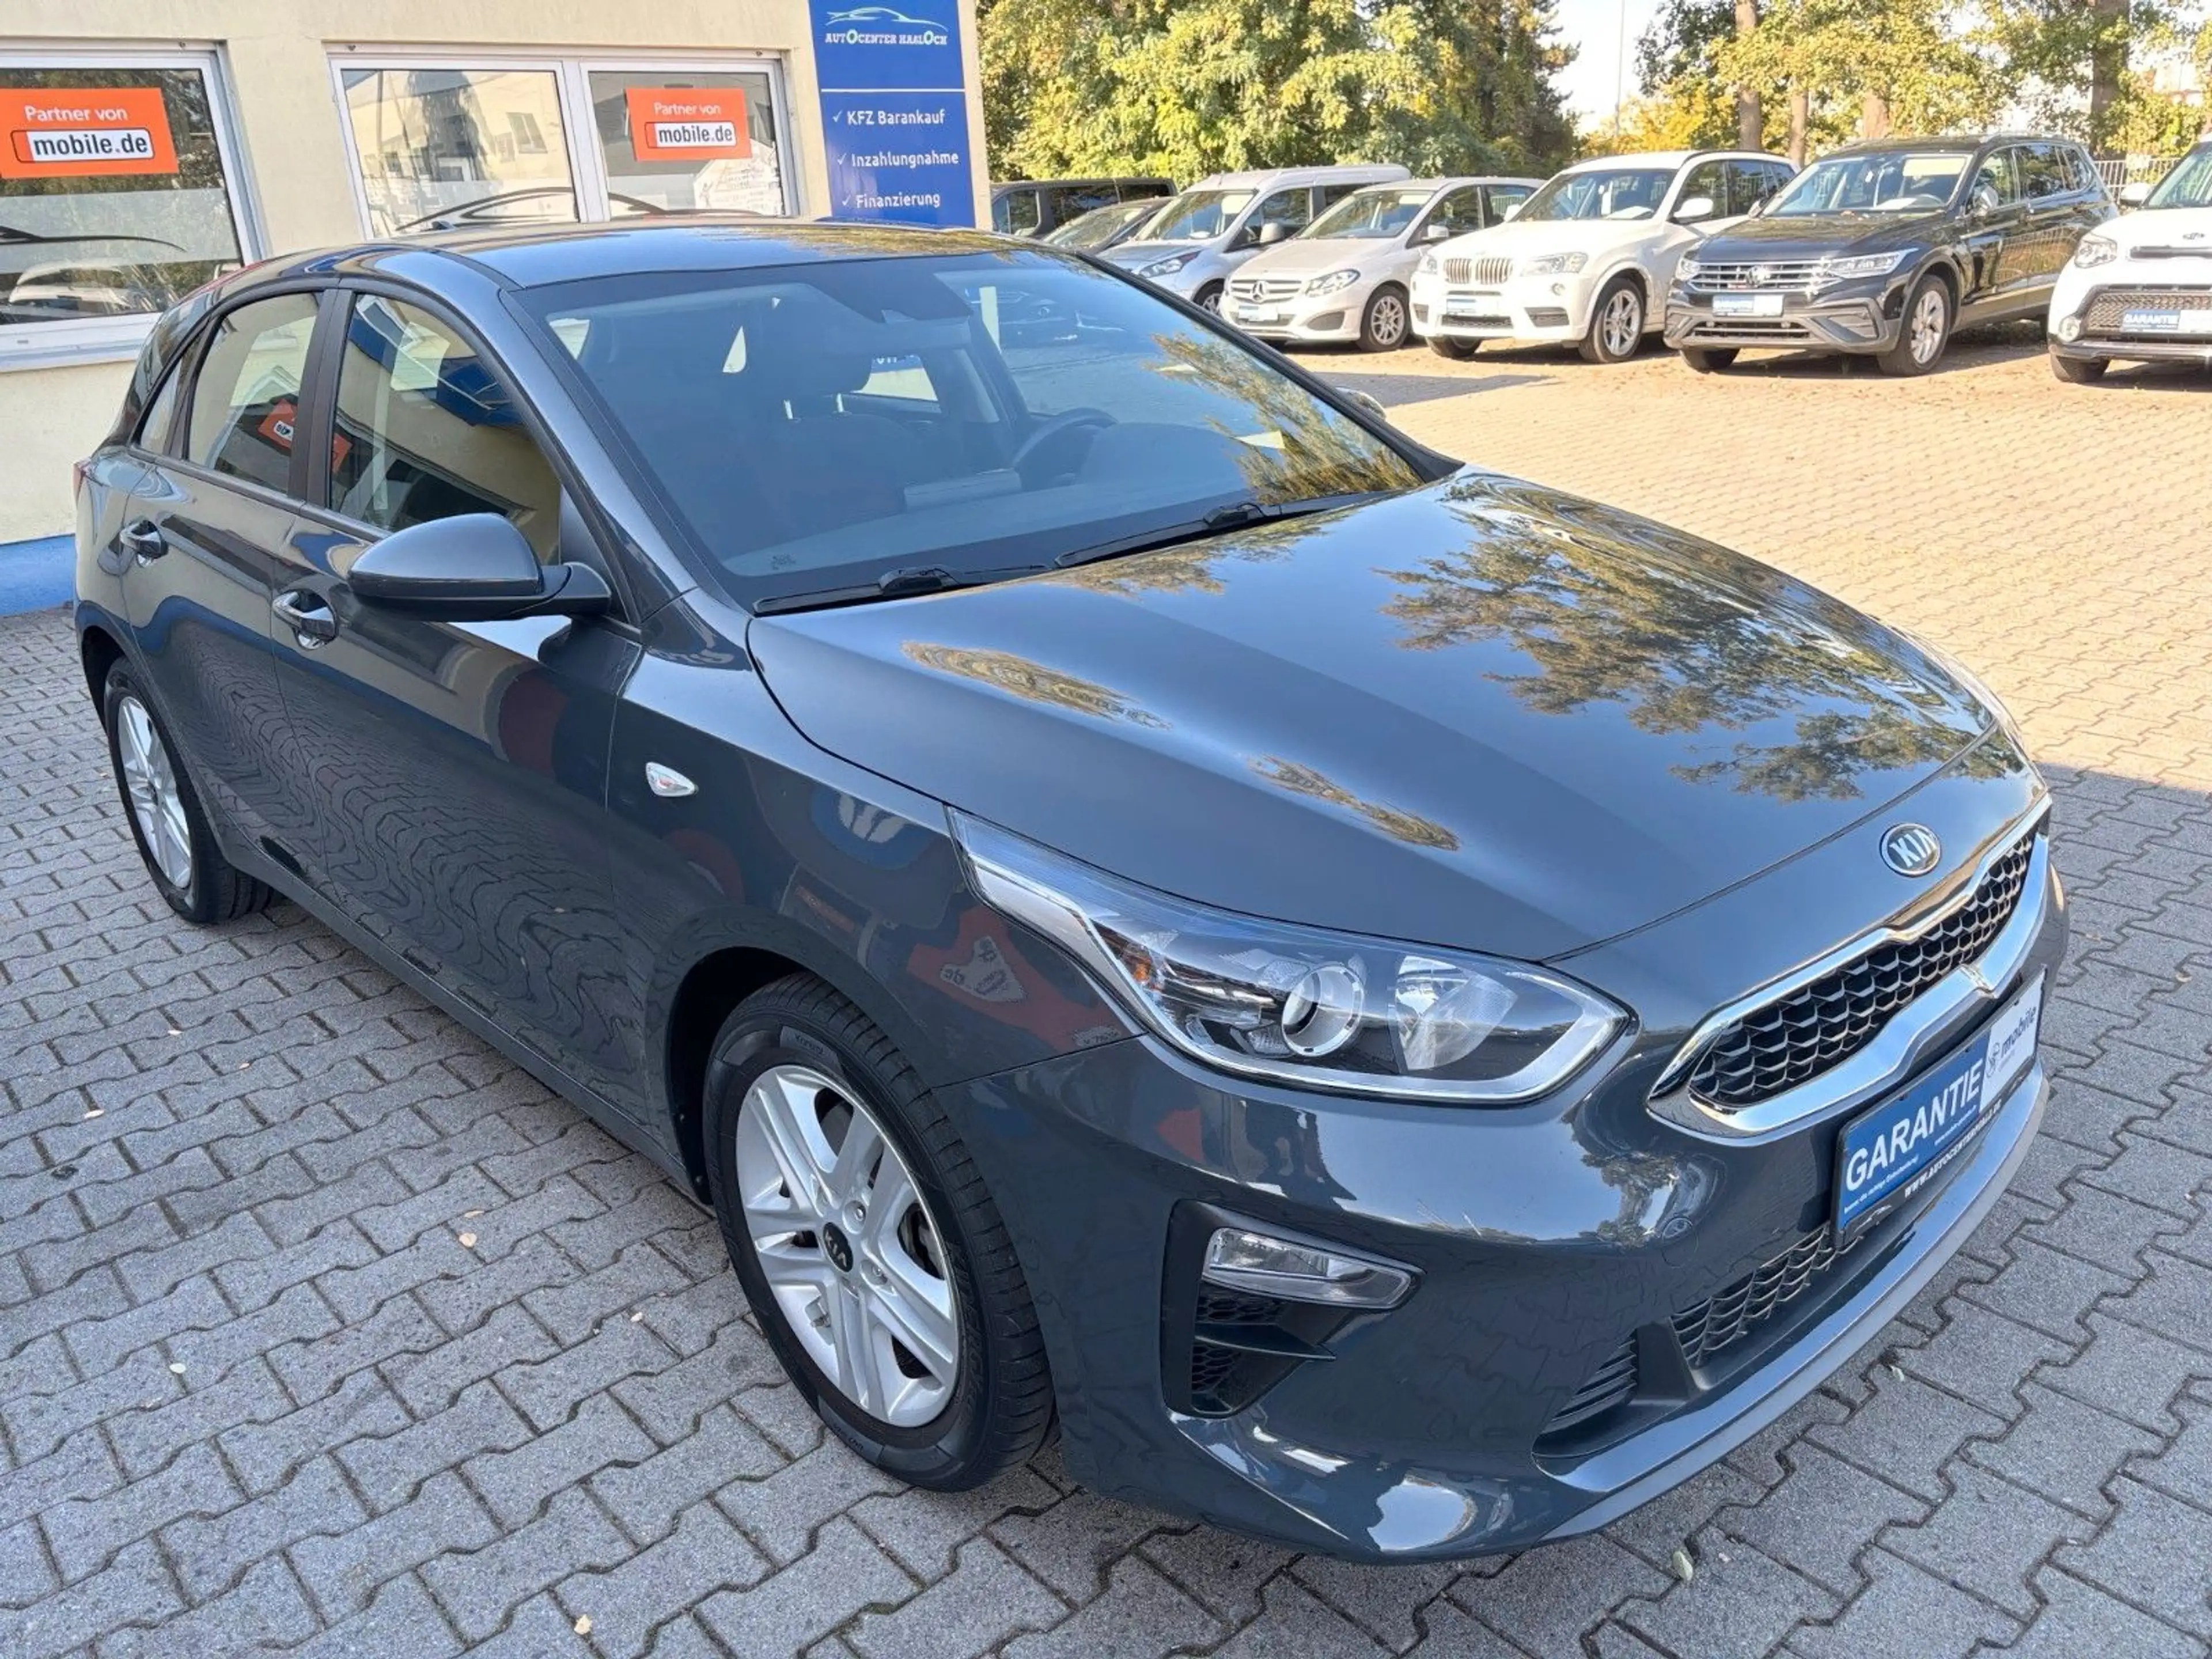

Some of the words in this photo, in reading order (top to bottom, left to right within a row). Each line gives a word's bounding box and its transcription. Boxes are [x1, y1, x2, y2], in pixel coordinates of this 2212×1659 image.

[825, 29, 896, 44] AUTOCENTER
[24, 105, 89, 122] Partner
[95, 108, 128, 122] von
[653, 101, 697, 116] Partner
[699, 104, 721, 115] von
[847, 111, 874, 125] KFZ
[877, 108, 945, 125] Barankauf
[658, 125, 733, 143] mobile.de
[33, 132, 147, 156] mobile.de
[851, 149, 959, 169] Inzahlungnahme
[856, 191, 940, 208] Finanzierung
[1846, 1058, 1983, 1192] GARANTIE
